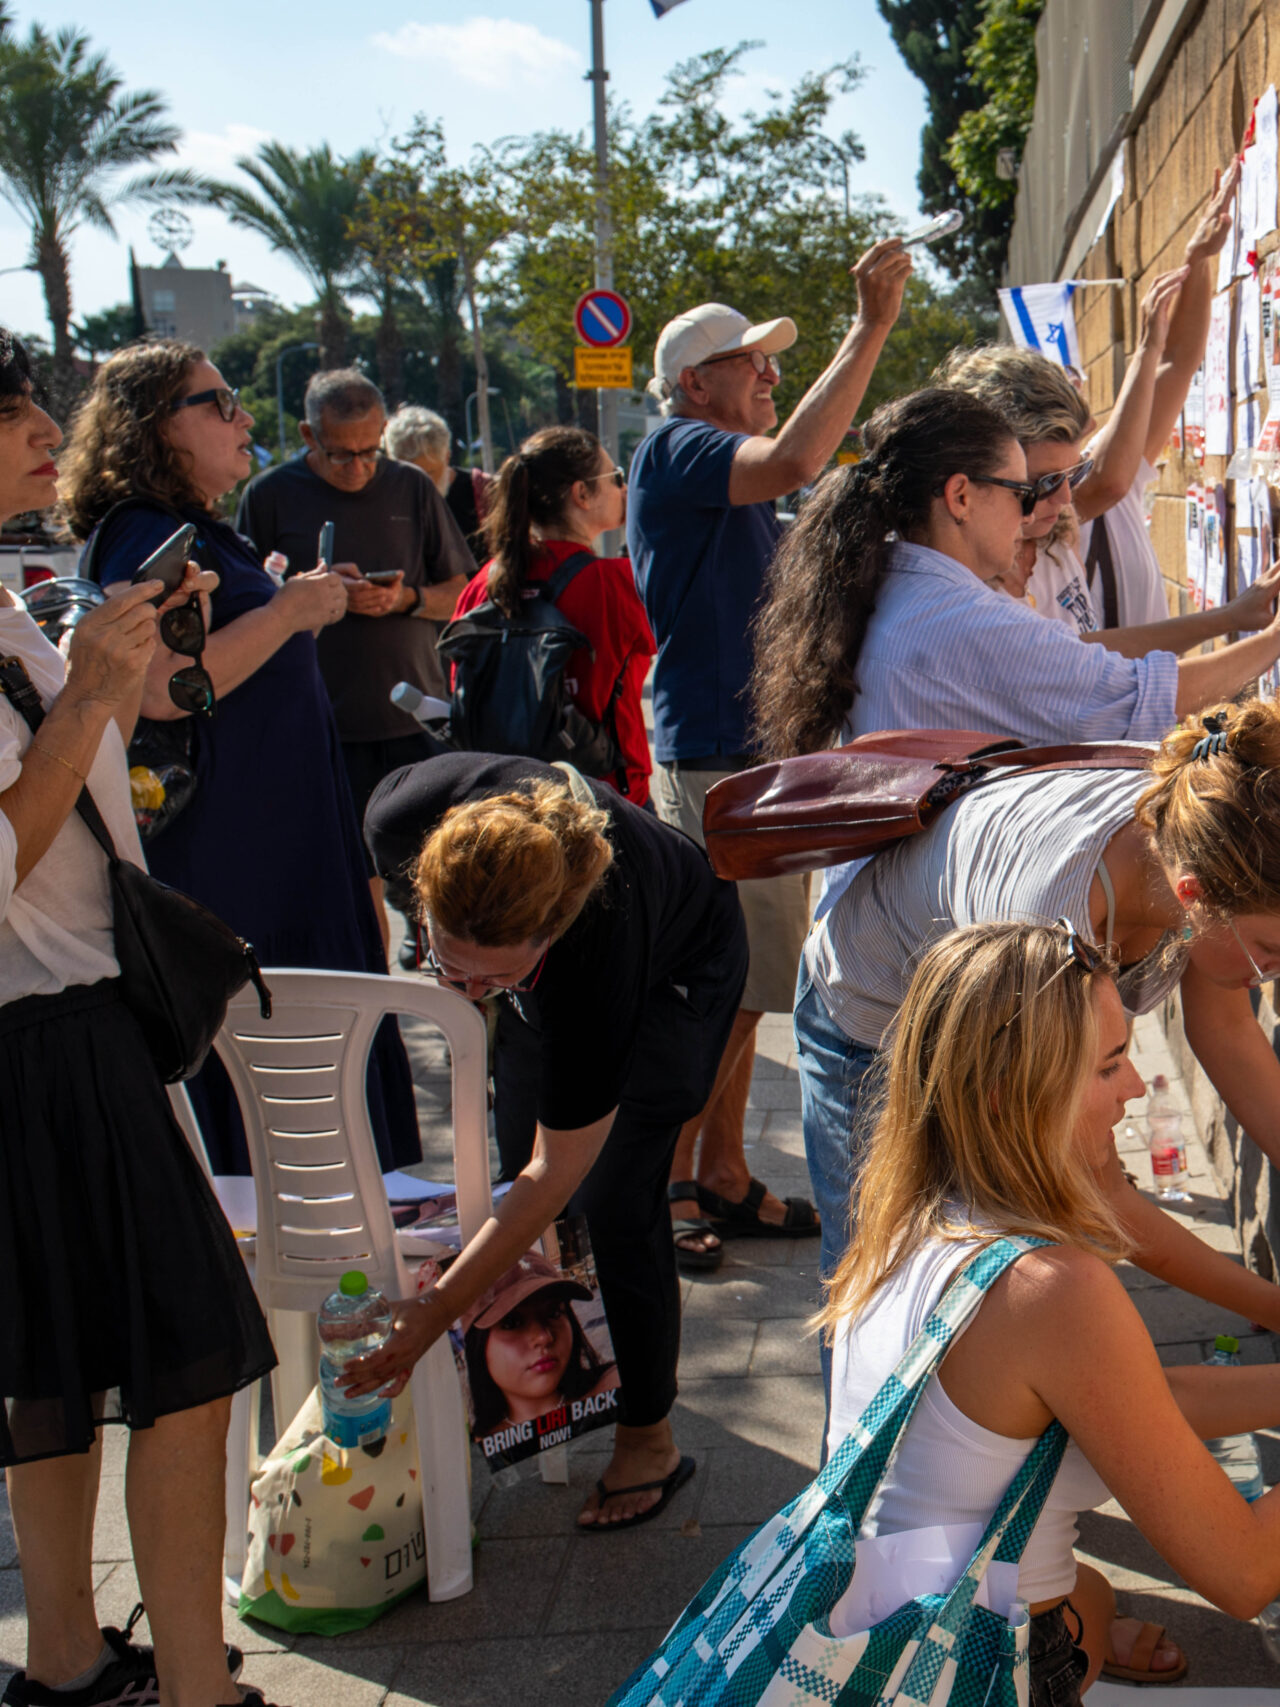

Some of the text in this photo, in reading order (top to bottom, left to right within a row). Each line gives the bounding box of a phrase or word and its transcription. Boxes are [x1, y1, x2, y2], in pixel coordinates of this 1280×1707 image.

[482, 1388, 618, 1457] BRING LIRI BACK
[540, 1426, 572, 1450] NOW!
